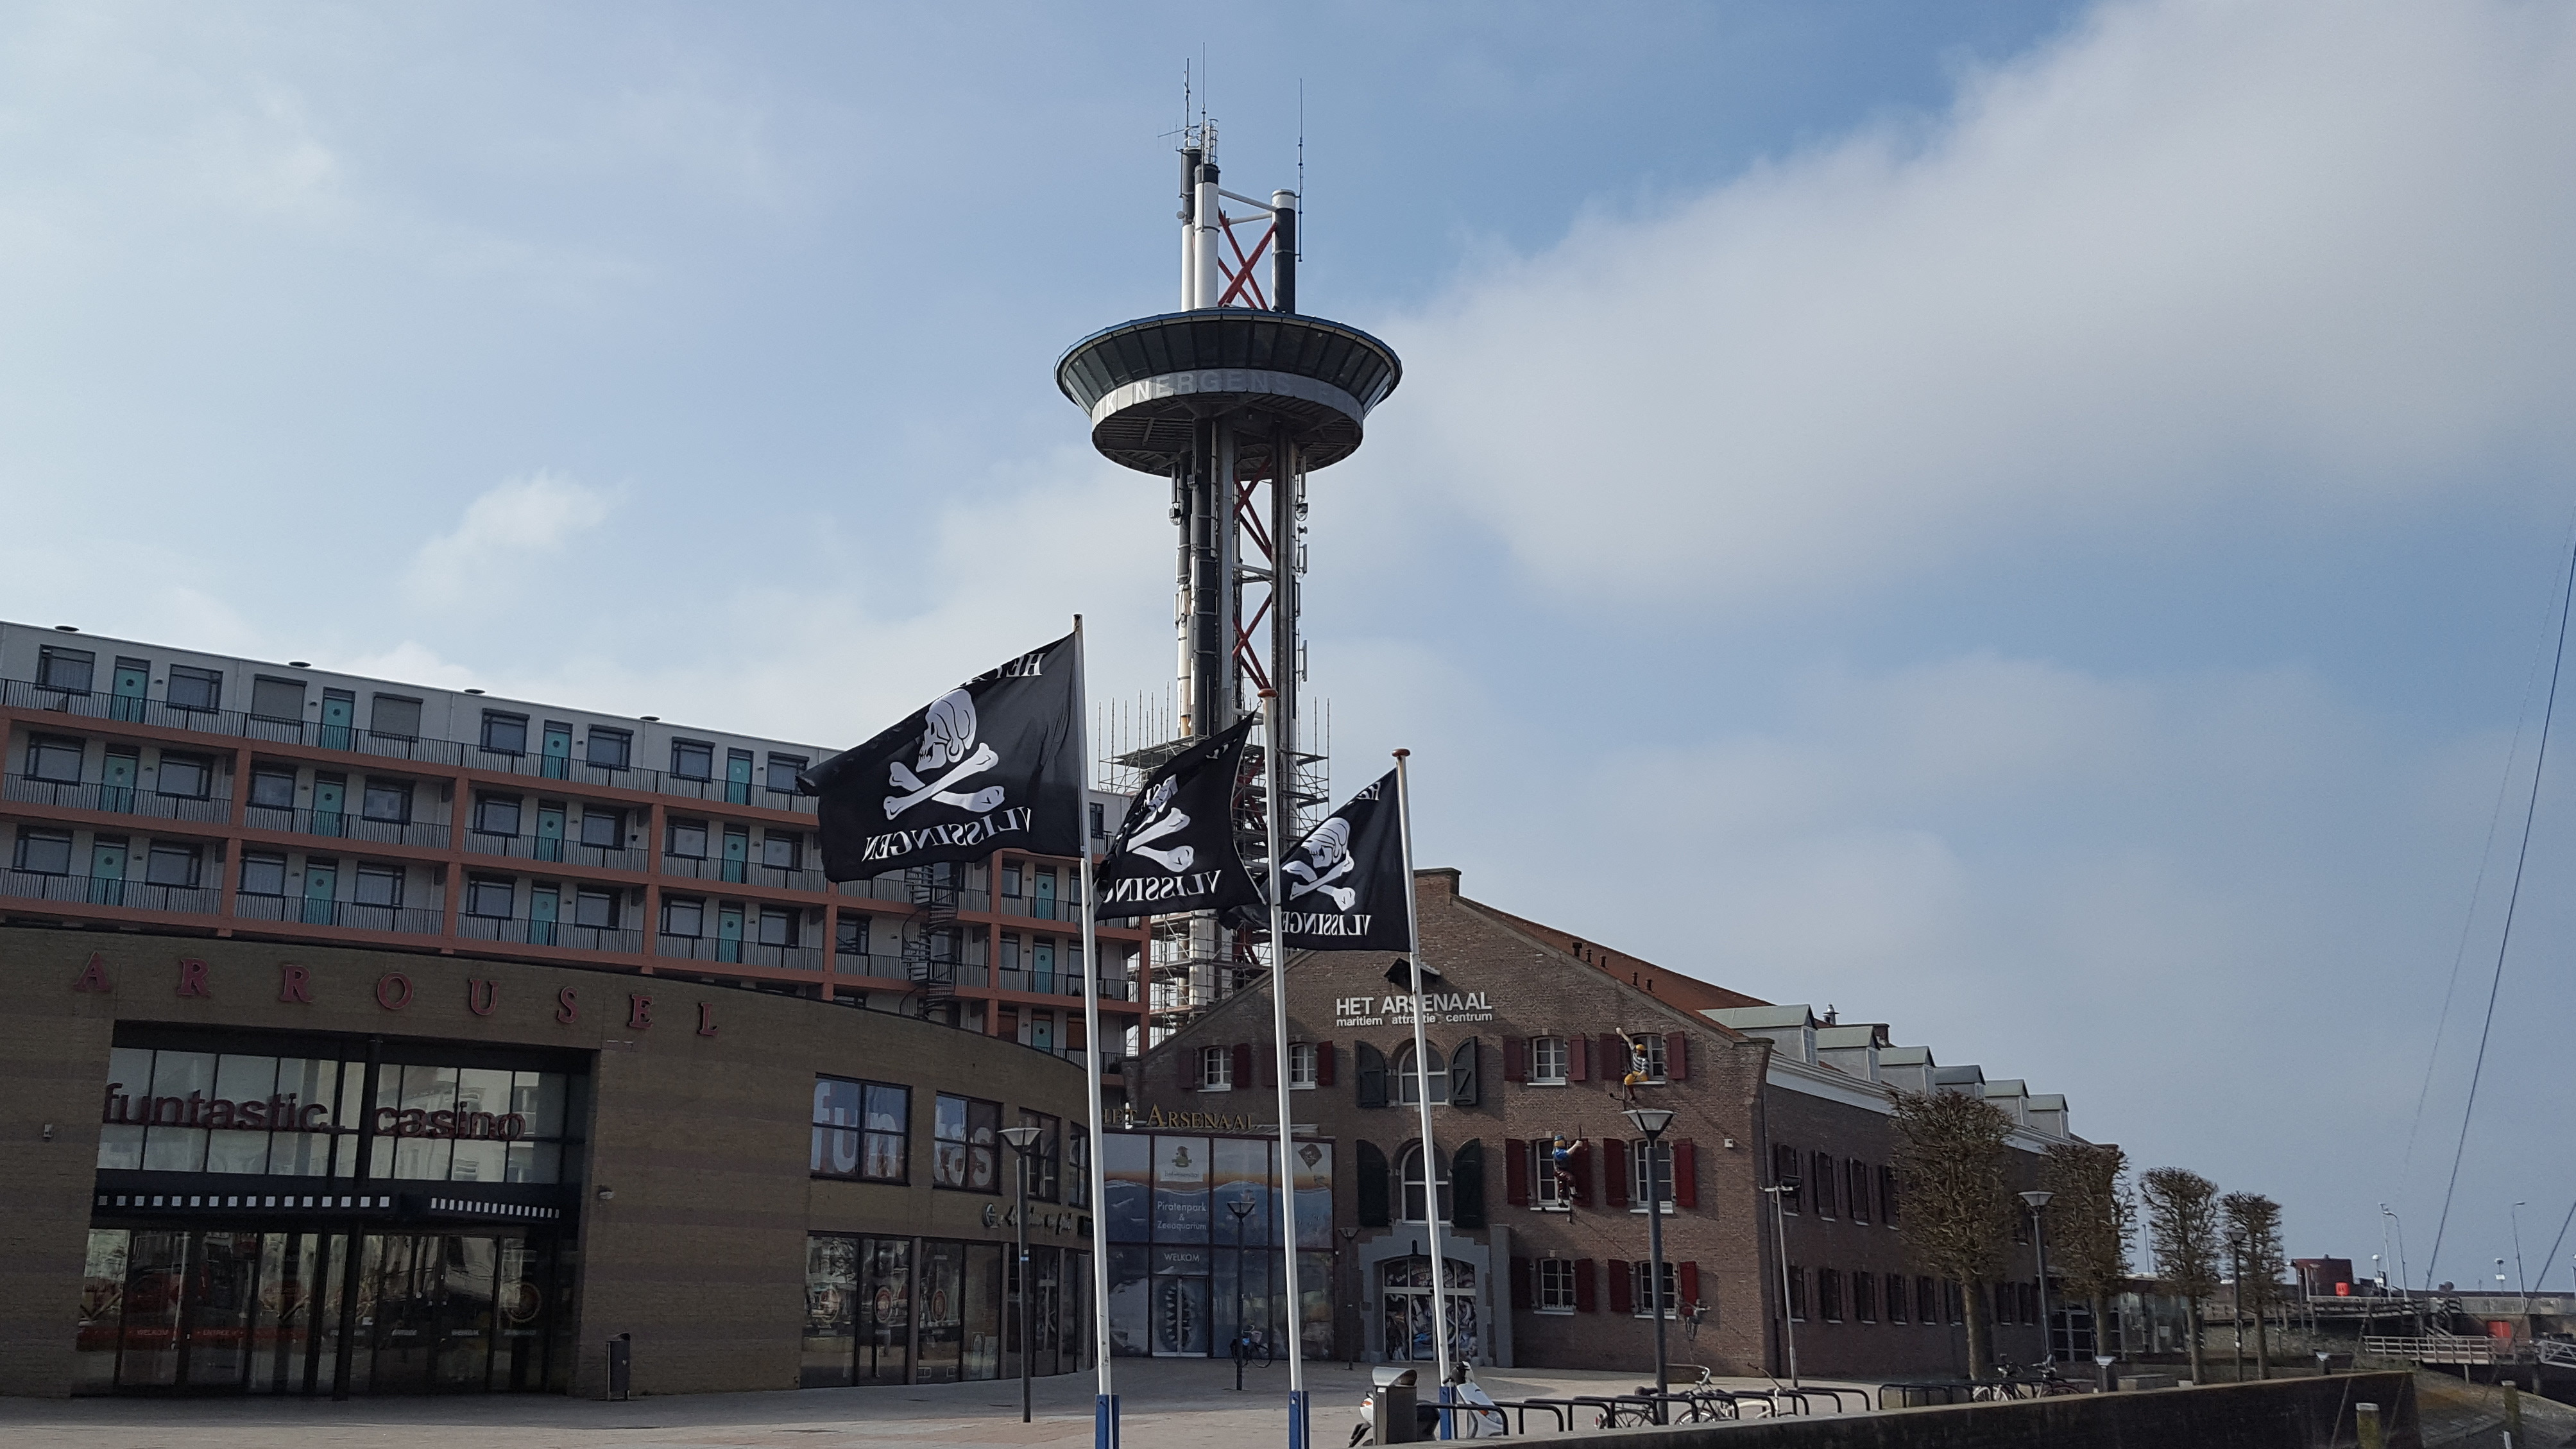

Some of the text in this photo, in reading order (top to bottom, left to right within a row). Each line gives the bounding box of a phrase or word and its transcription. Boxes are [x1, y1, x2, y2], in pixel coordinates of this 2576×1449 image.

[1135, 370, 1292, 402] NERGENS
[1336, 997, 1374, 1015] HET
[1336, 1012, 1492, 1027] maritiem attratie centrum
[103, 1083, 526, 1141] funtastic casino
[1147, 1102, 1256, 1130] ARSENAAL
[810, 1081, 897, 1178] fun
[1157, 1201, 1207, 1214] Piratenpark
[1157, 1221, 1207, 1231] Zeeaquarium
[1164, 1253, 1200, 1262] WELKOM
